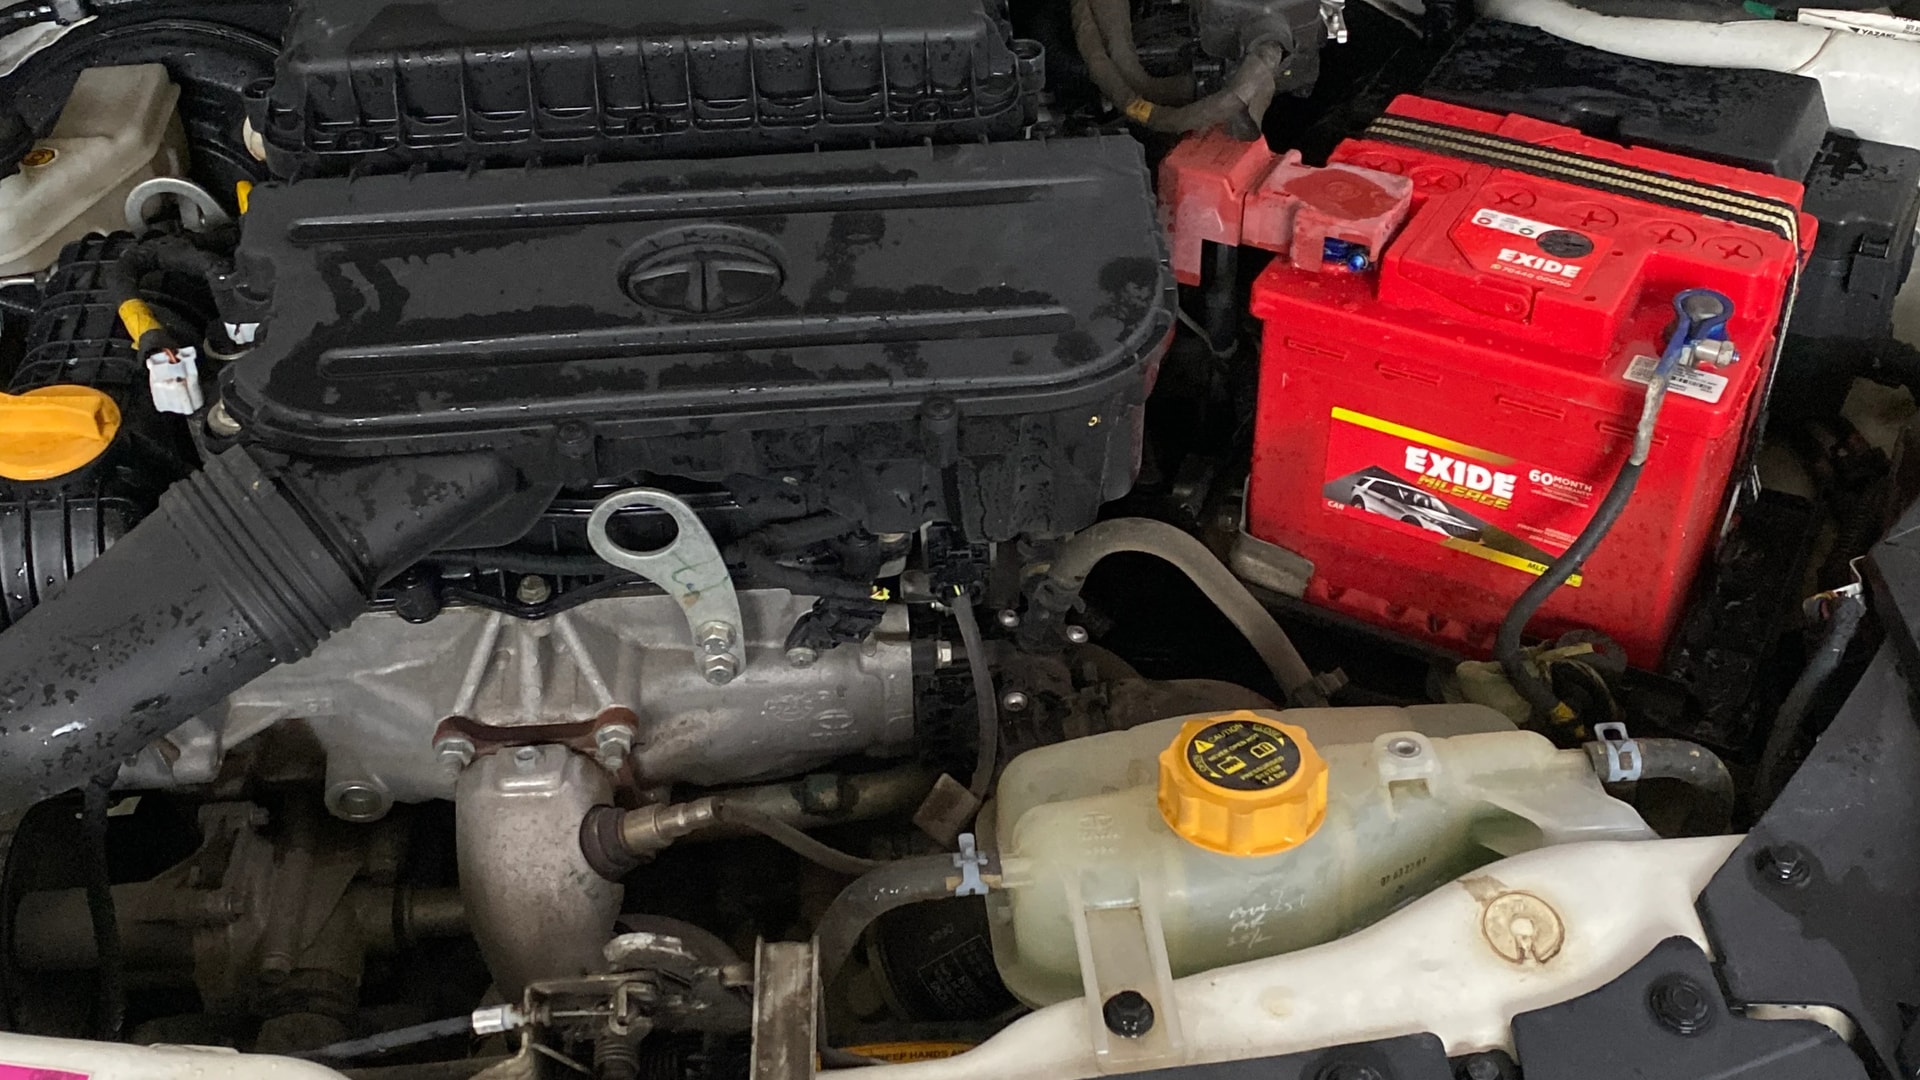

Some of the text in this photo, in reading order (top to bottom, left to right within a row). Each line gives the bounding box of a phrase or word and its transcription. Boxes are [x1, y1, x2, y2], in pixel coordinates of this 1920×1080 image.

[1497, 248, 1583, 279] EXIDE
[1405, 445, 1518, 500] EXIDE
[1528, 469, 1553, 486] 60
[1553, 475, 1593, 493] MONTH
[1417, 474, 1513, 511] MILEAGE
[1327, 500, 1345, 511] CAR
[1207, 723, 1243, 742] CAUTION
[1208, 748, 1229, 761] NEVER
[1228, 740, 1247, 751] OPEN
[910, 1049, 948, 1060] HANDS
